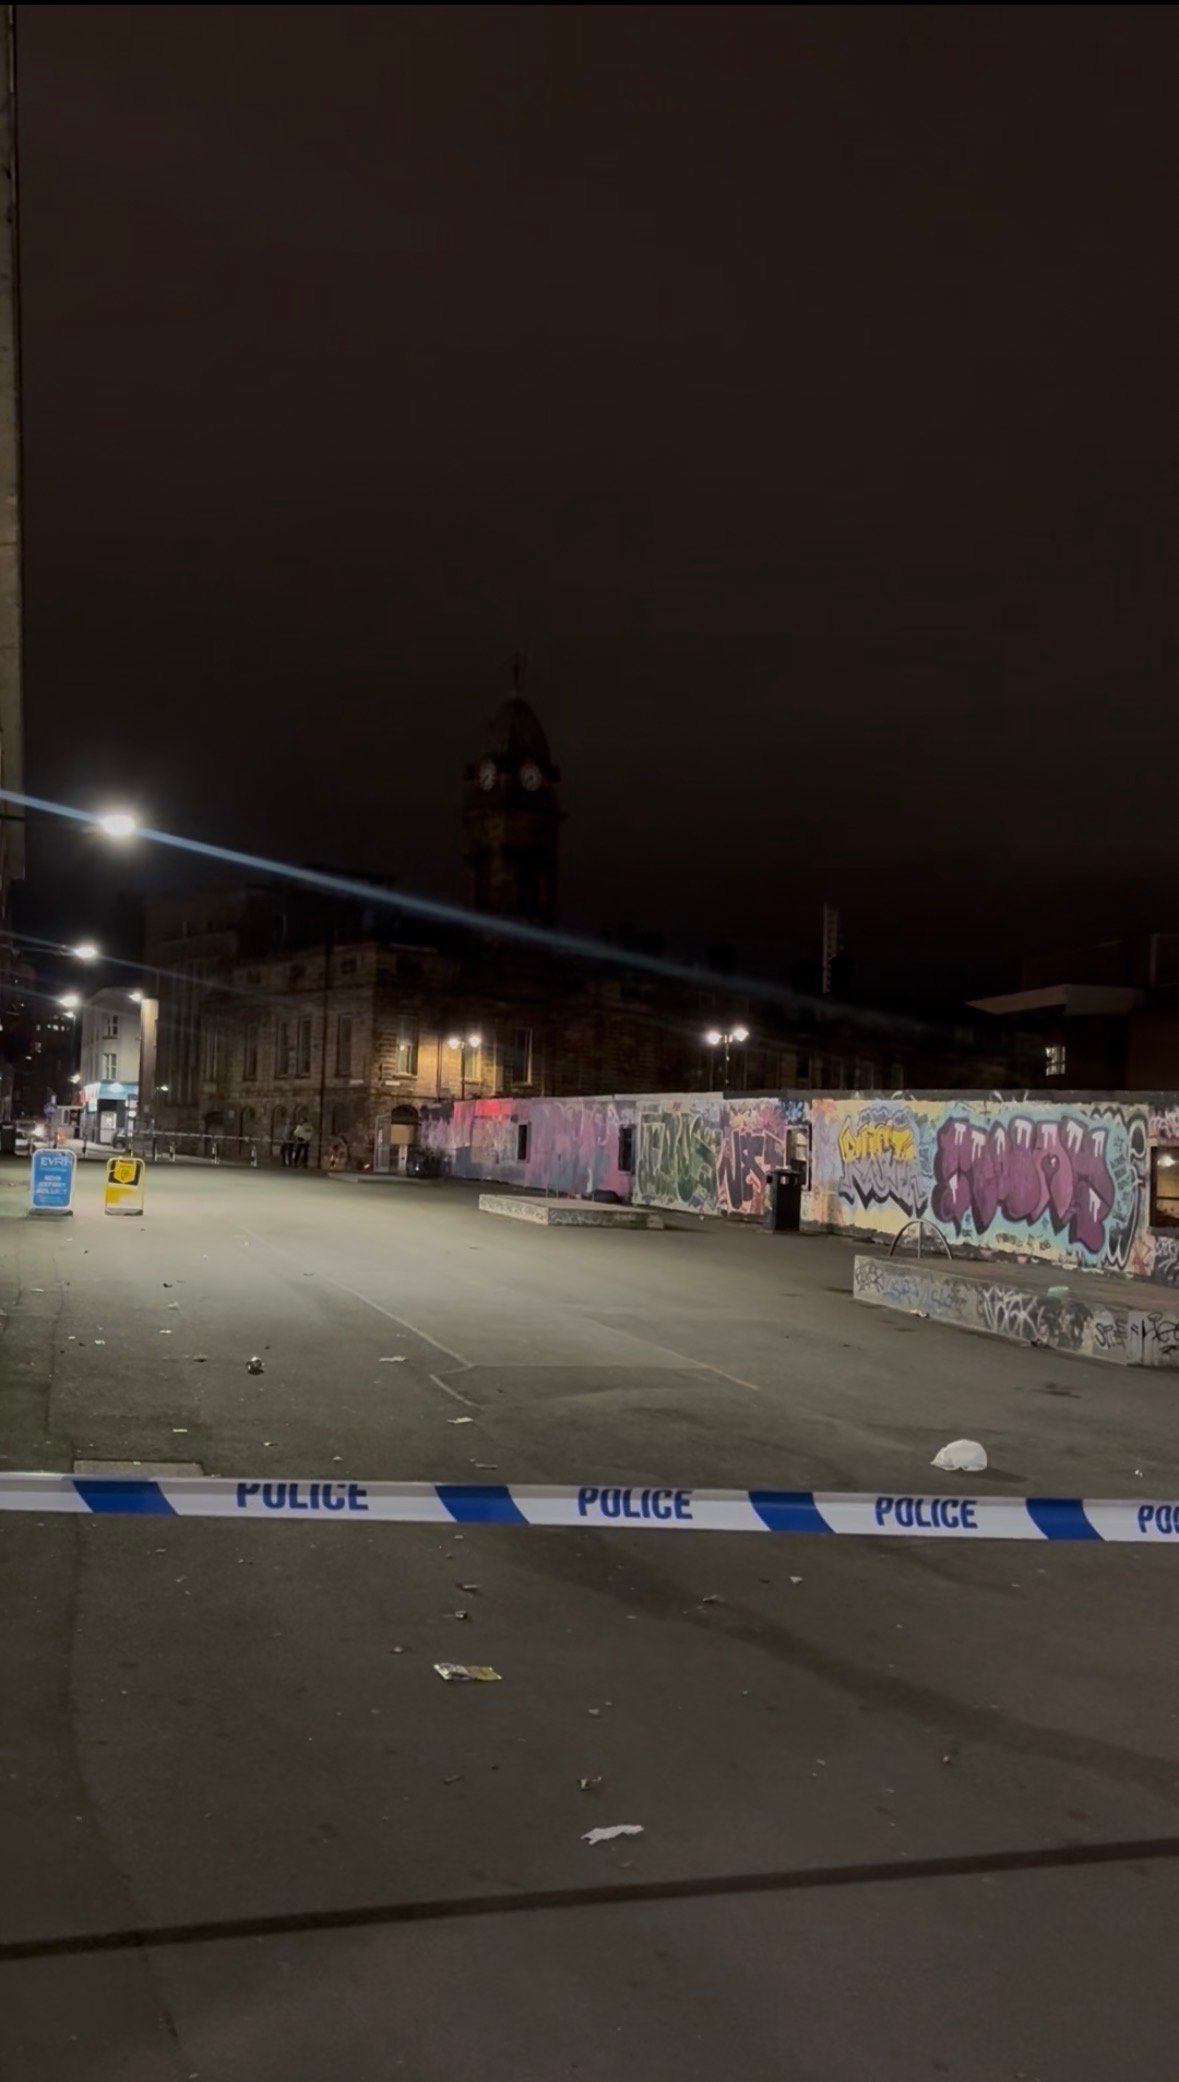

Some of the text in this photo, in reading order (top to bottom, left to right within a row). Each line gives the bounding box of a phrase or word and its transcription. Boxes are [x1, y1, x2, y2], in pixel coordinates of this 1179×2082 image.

[236, 1482, 369, 1511] POLICE
[577, 1486, 693, 1520] POLICE
[875, 1496, 978, 1529] POLICE
